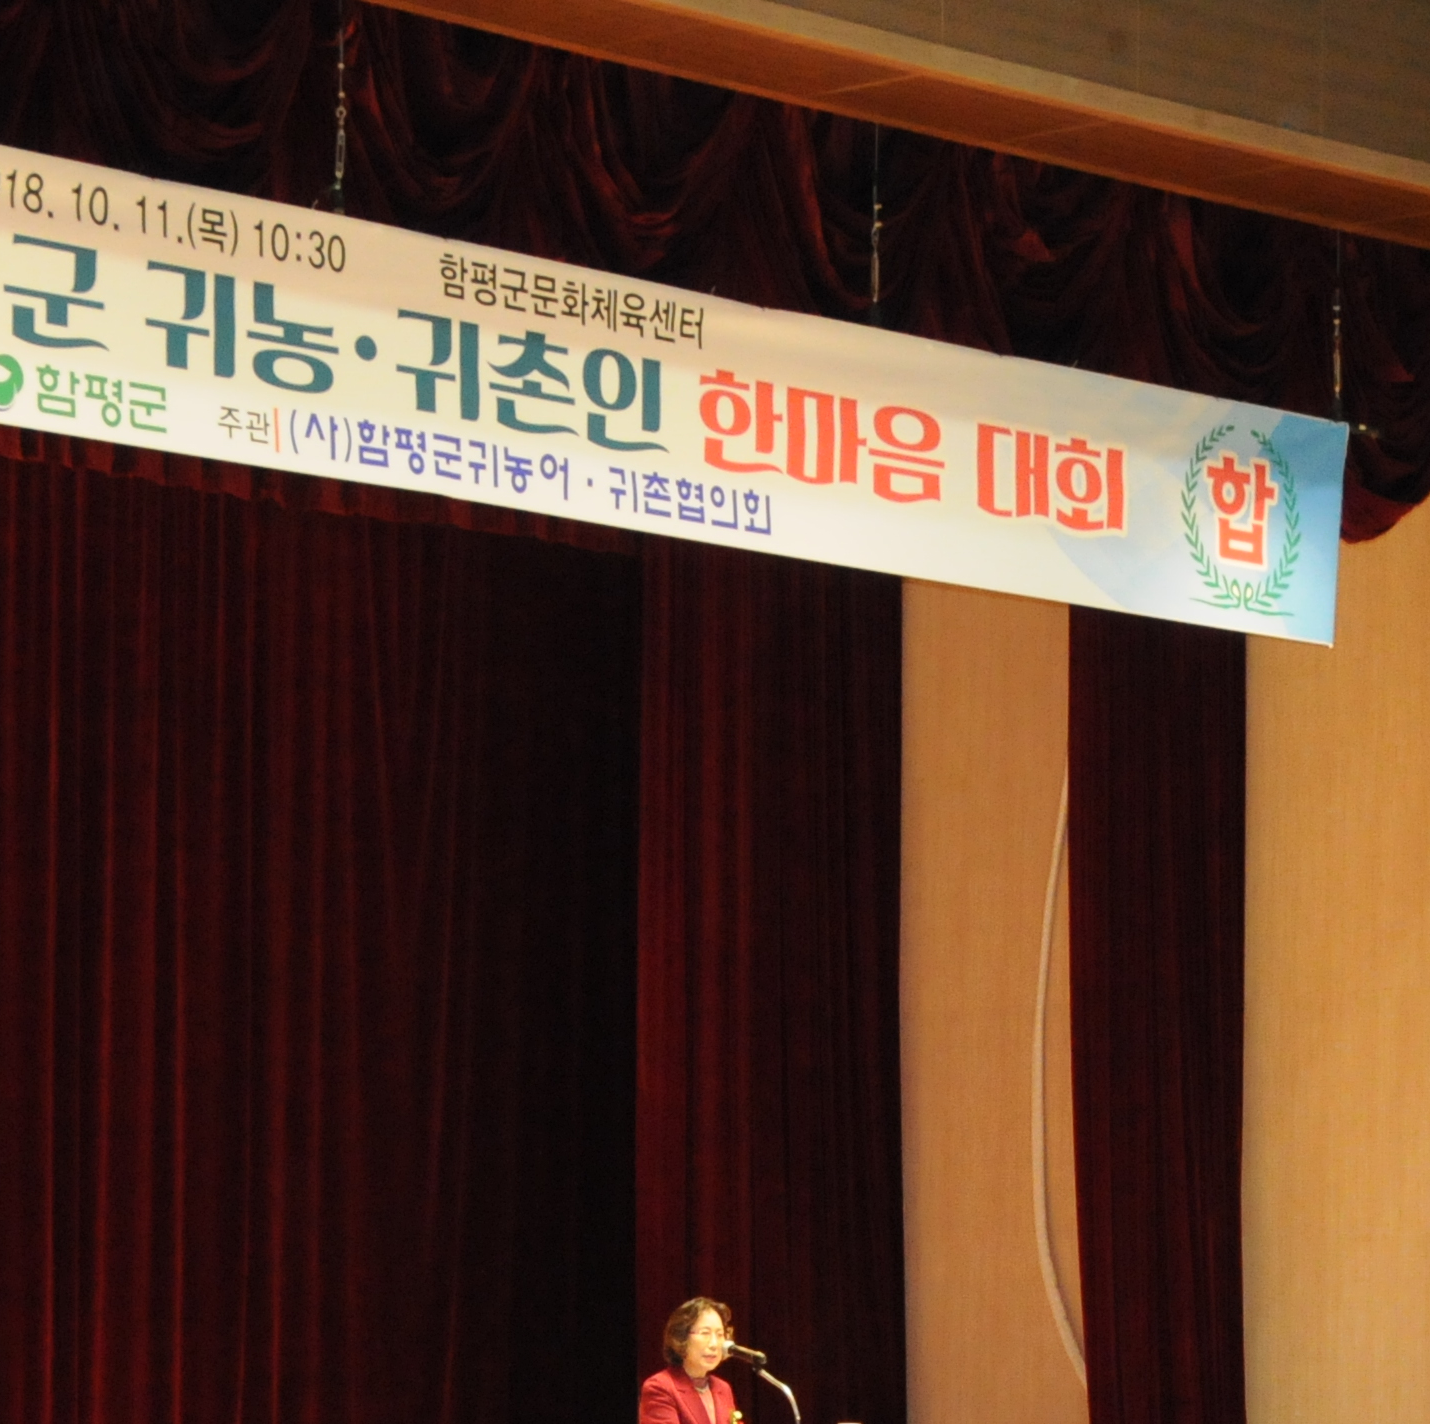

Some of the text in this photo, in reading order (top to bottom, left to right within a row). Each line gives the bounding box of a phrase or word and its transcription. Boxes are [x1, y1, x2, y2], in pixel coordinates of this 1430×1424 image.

[252, 223, 348, 274] 10:30
[439, 251, 706, 349] 함평군문화체육센터
[37, 363, 168, 434] 함평군
[218, 406, 270, 445] 주관
[698, 368, 946, 505] 한마음
[977, 422, 1125, 532] 대회
[1206, 456, 1275, 565] 합
